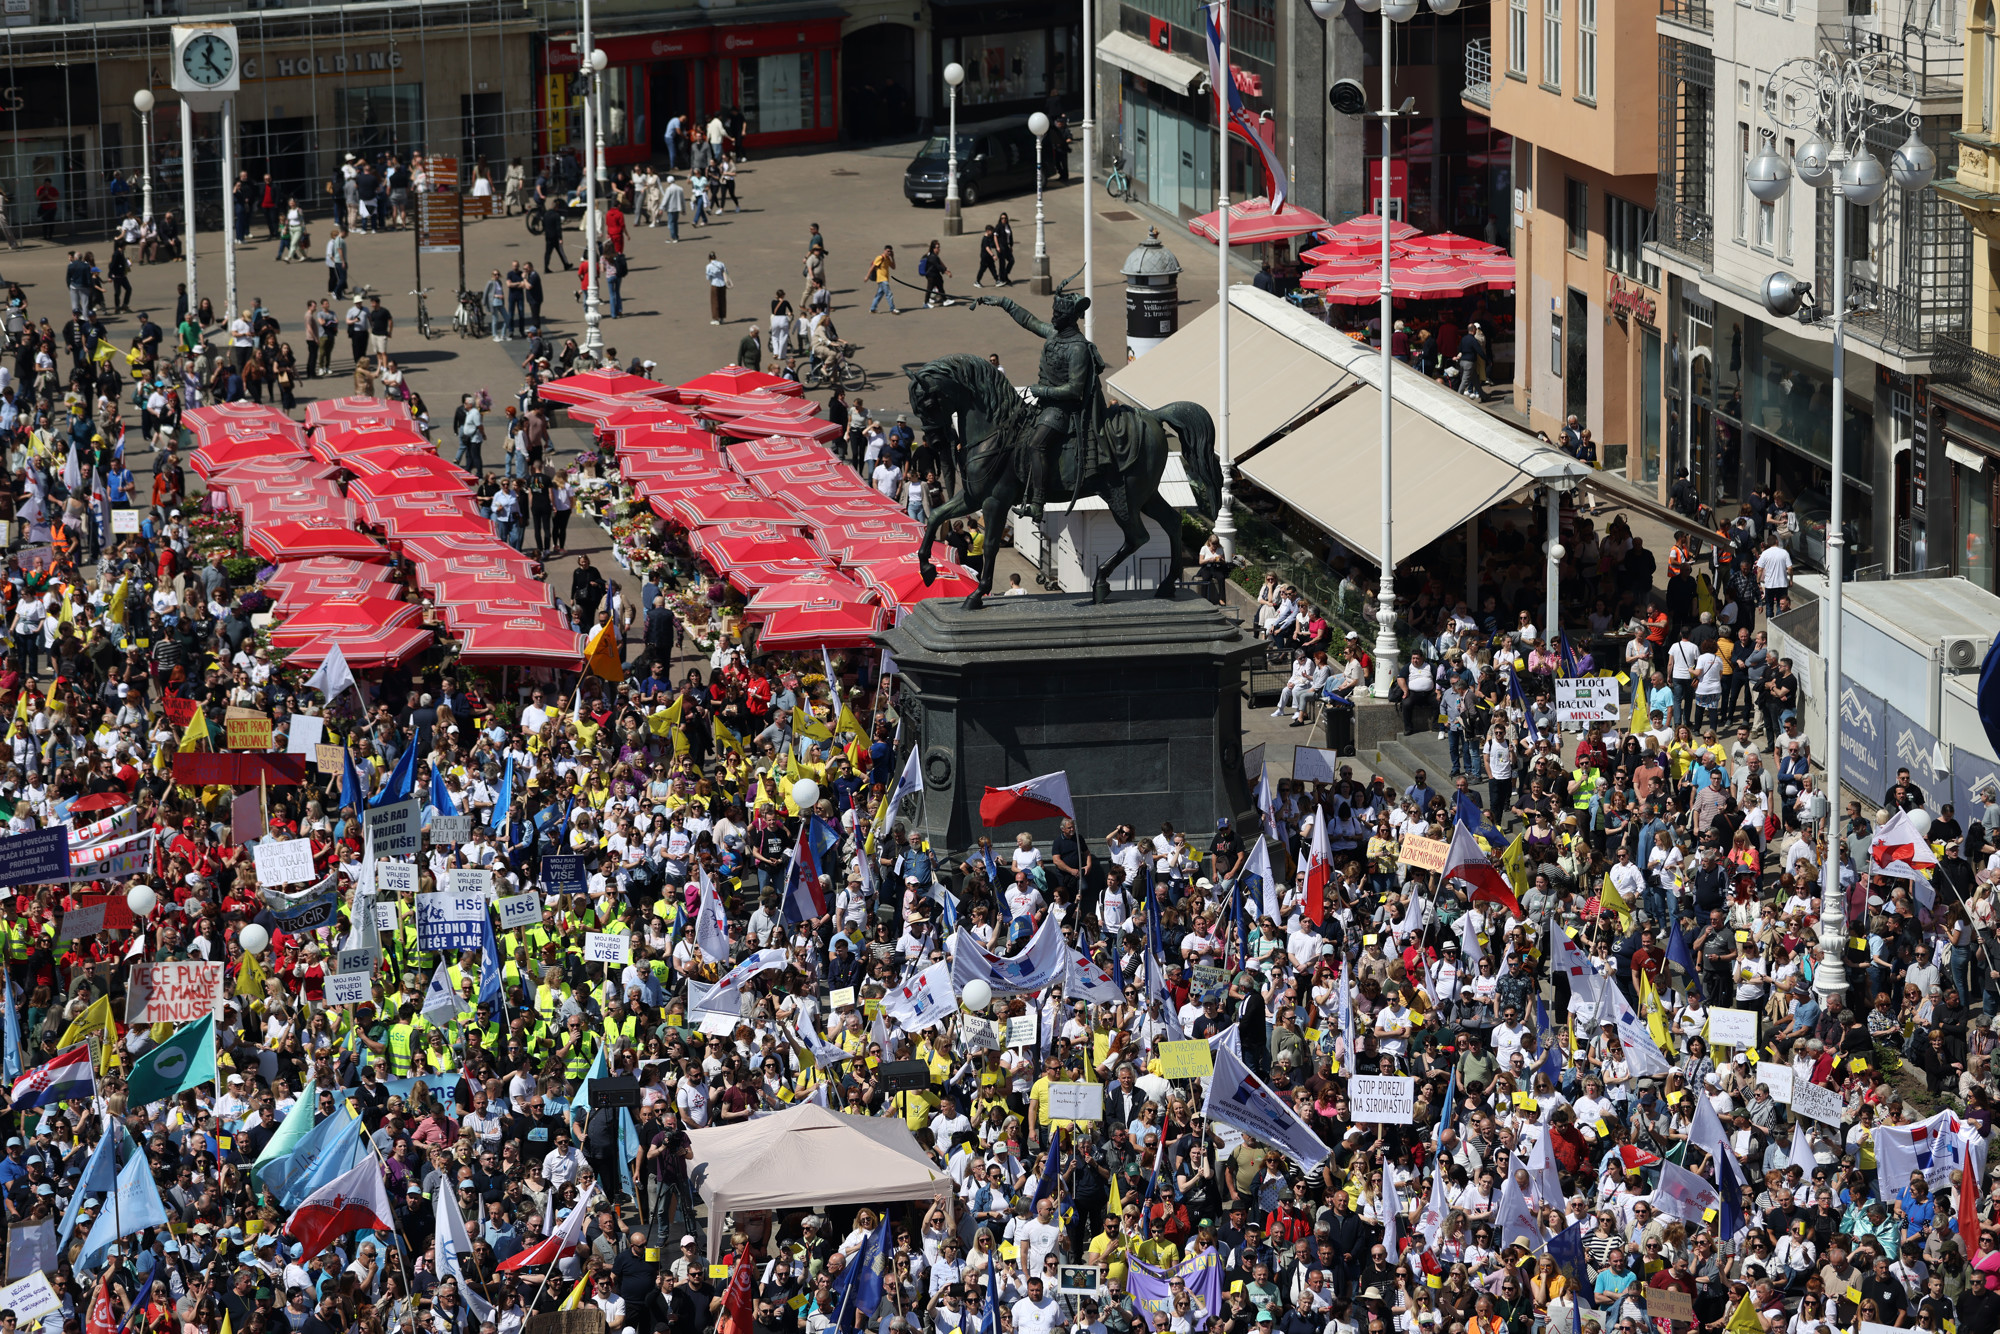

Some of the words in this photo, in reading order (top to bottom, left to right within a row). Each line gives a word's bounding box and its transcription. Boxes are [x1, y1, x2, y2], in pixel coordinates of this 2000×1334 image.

[279, 51, 404, 77] HOLDING
[551, 78, 560, 123] ATM
[1576, 677, 1604, 687] PLOČI
[1558, 698, 1597, 709] RAČUNU
[1570, 711, 1604, 720] MINUS!
[229, 720, 248, 733] NEMAM
[250, 720, 271, 733] PRAVO
[229, 735, 240, 747] NA
[240, 734, 268, 747] BOLOVANJE
[371, 812, 388, 826] NAŠ
[390, 808, 408, 822] RAD
[373, 823, 407, 840] VRIJEDI
[23, 833, 59, 847] POVEĆANJE
[390, 836, 416, 851] VIŠE!
[1407, 837, 1430, 849] SINDIKAT
[1431, 843, 1450, 855] PROTIV
[20, 849, 24, 857] U
[25, 845, 49, 856] SKLADU
[93, 847, 104, 861] O
[109, 835, 151, 859] DJECI
[10, 860, 40, 869] PROFITOM
[37, 864, 60, 876] ŽIVOTA
[280, 906, 326, 931] TROGIR
[419, 922, 467, 937] ZAJEDNO
[472, 922, 483, 934] ZA
[420, 934, 447, 950] VEĆE
[453, 934, 483, 948] PLAĆE
[133, 962, 170, 987] VEĆE
[177, 960, 221, 985] PLAĆE
[347, 975, 361, 983] RAD
[146, 984, 168, 1002] ZA
[334, 982, 362, 991] VRIJEDI
[147, 1001, 214, 1023] MINUSE
[970, 1018, 991, 1030] SESTRE
[965, 1026, 998, 1040] ZASLUŽUJU
[972, 1036, 992, 1048] VIŠE!!!
[1160, 1044, 1172, 1054] RAD
[1176, 1053, 1196, 1066] NIJE
[1192, 1064, 1211, 1076] RADA
[1357, 1080, 1376, 1095] STOP
[1378, 1081, 1405, 1095] POREZU
[1353, 1098, 1363, 1111] NA
[1365, 1094, 1411, 1114] SIROMAŠTVO
[1219, 1100, 1244, 1115] HRVATSKI
[1242, 1109, 1270, 1128] STRUKOVNI
[1225, 1110, 1247, 1123] SESTARA
